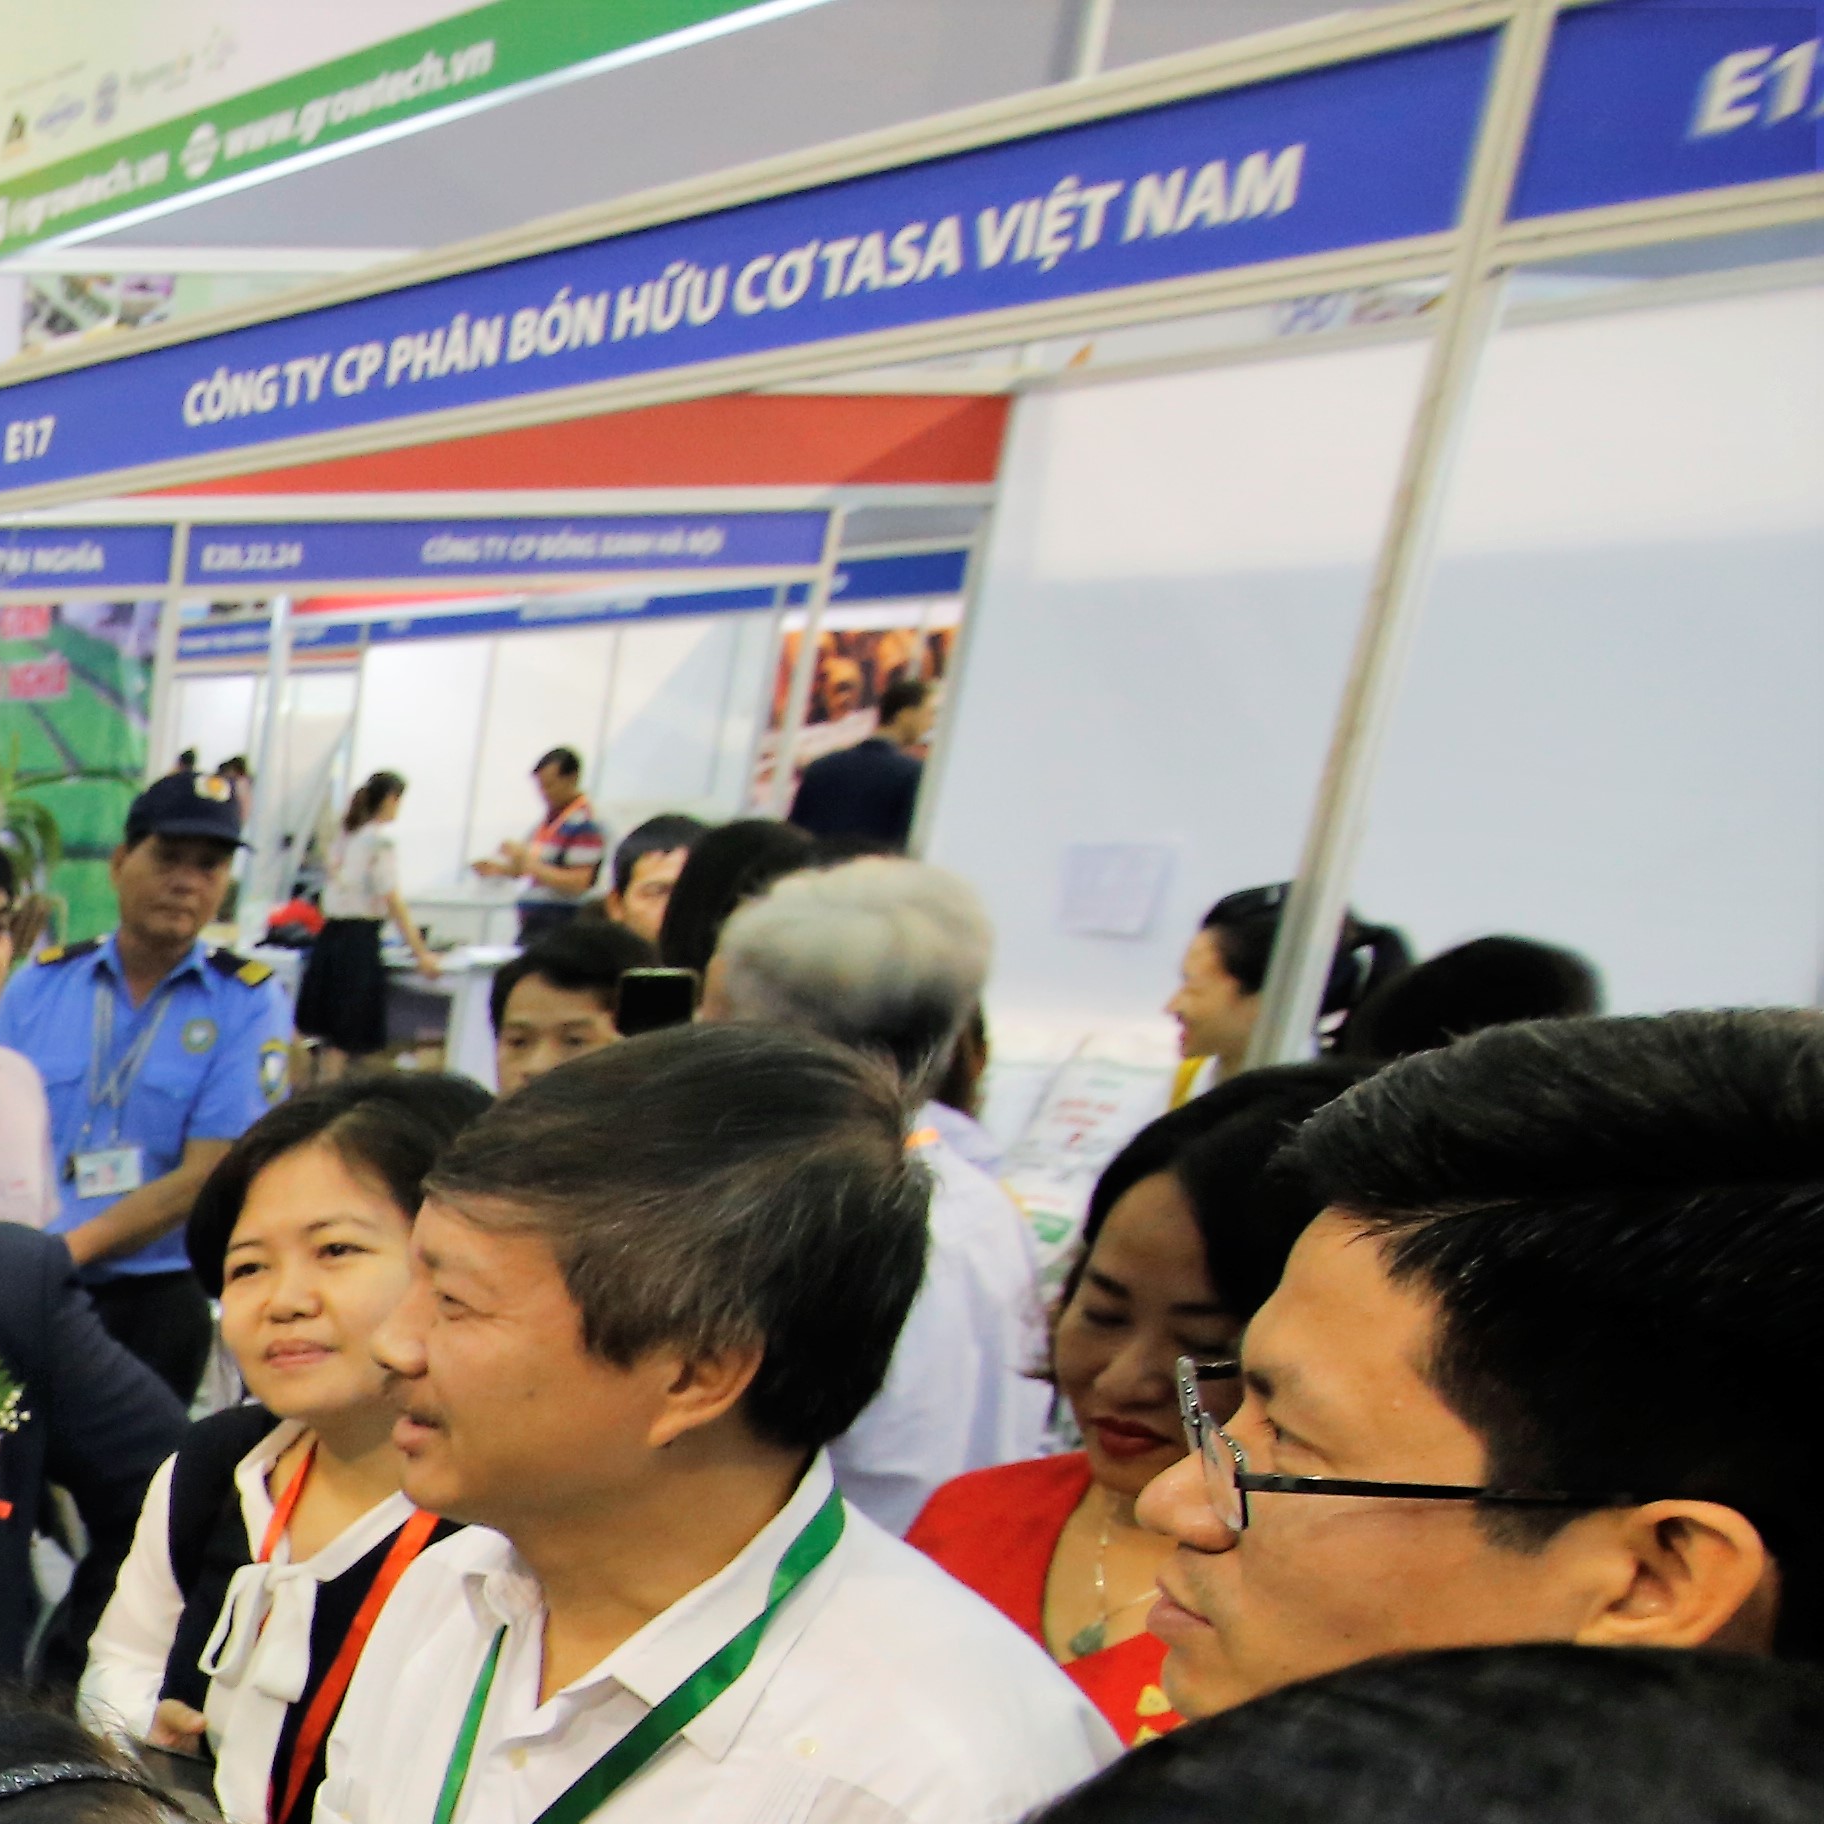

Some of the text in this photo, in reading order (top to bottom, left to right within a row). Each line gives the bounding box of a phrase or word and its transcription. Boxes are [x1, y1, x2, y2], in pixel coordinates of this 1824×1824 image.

[224, 40, 495, 160] www.growtech.vn
[1688, 38, 1824, 141] E1
[182, 144, 1306, 427] CÔNG TY CP PHÂN BÓN HỮU CƠ TASA VIỆT NAM
[4, 416, 56, 464] E17
